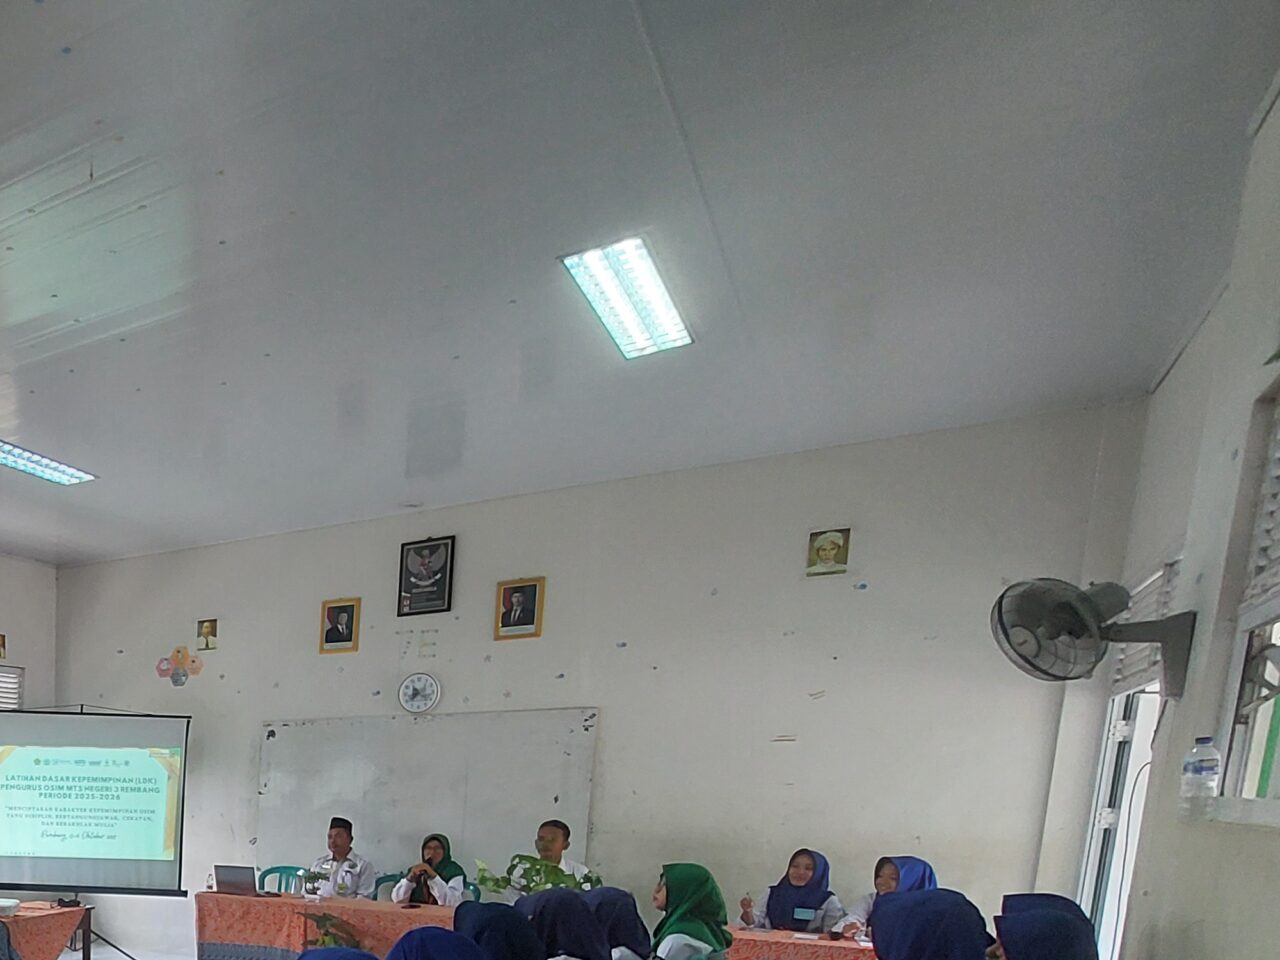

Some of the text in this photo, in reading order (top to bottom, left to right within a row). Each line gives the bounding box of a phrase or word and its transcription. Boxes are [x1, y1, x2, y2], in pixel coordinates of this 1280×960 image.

[71, 776, 134, 784] KEPEMIMPINAN
[135, 777, 158, 786] (LDK)
[0, 783, 42, 791] PENGURUS
[84, 785, 113, 793] NEGERI
[120, 786, 161, 794] REMBANG
[38, 792, 121, 801] PERIODE 2025-2026
